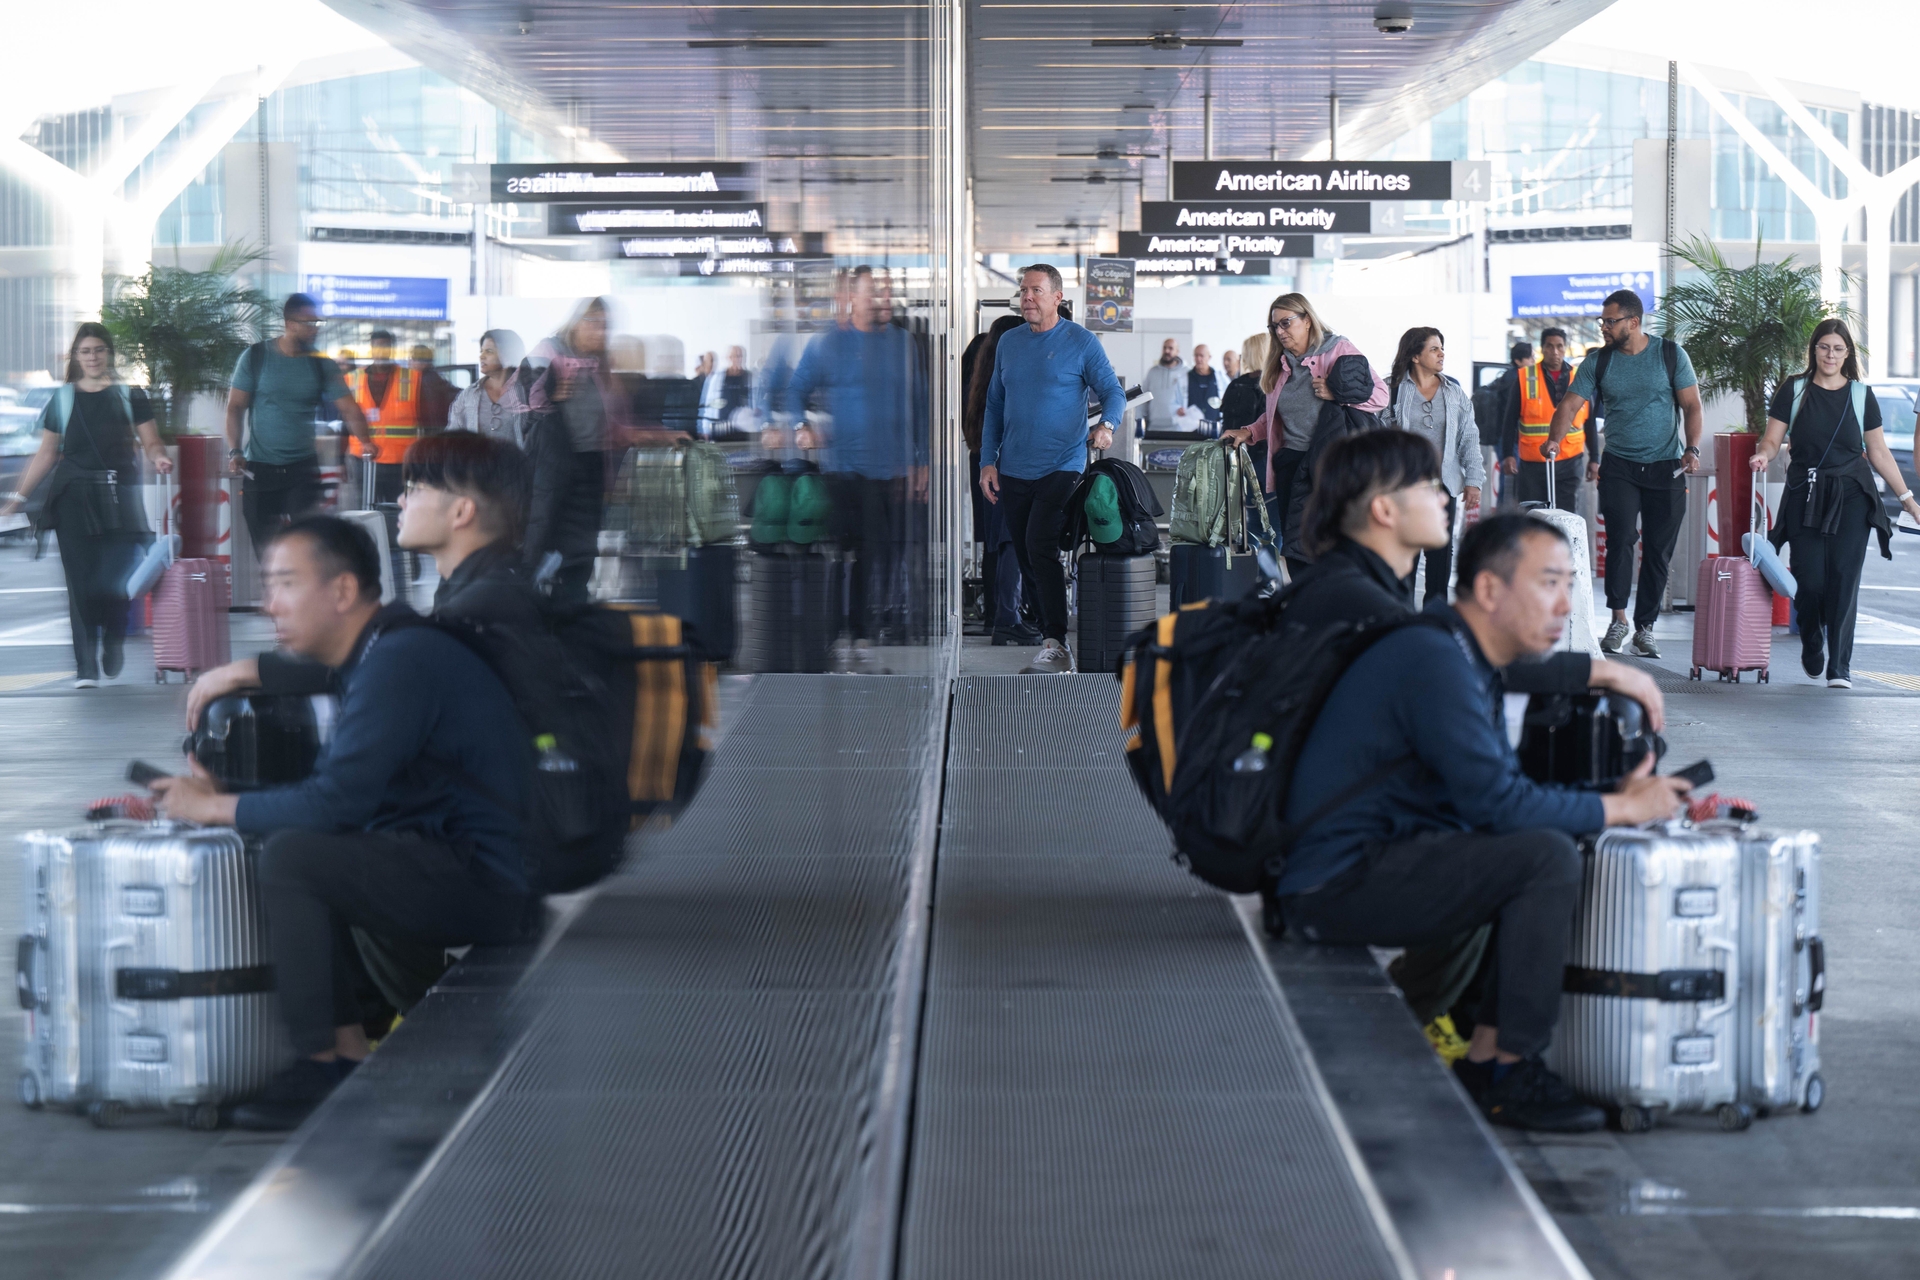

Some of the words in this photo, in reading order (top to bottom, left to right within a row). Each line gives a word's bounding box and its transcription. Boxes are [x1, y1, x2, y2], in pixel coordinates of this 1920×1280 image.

[1215, 170, 1322, 191] American
[1326, 170, 1411, 191] Airlines
[1463, 168, 1482, 193] 4
[1176, 208, 1265, 227] American
[1270, 207, 1336, 230] Priority
[1380, 207, 1396, 228] 4
[1227, 235, 1285, 256] Priority
[1322, 234, 1336, 254] 4
[1136, 257, 1193, 272] merican
[1195, 257, 1245, 275] Priity
[1568, 276, 1610, 287] Terminal
[1561, 290, 1605, 300] Terminals
[1518, 306, 1541, 315] Hotel
[1551, 304, 1585, 315] Parking
